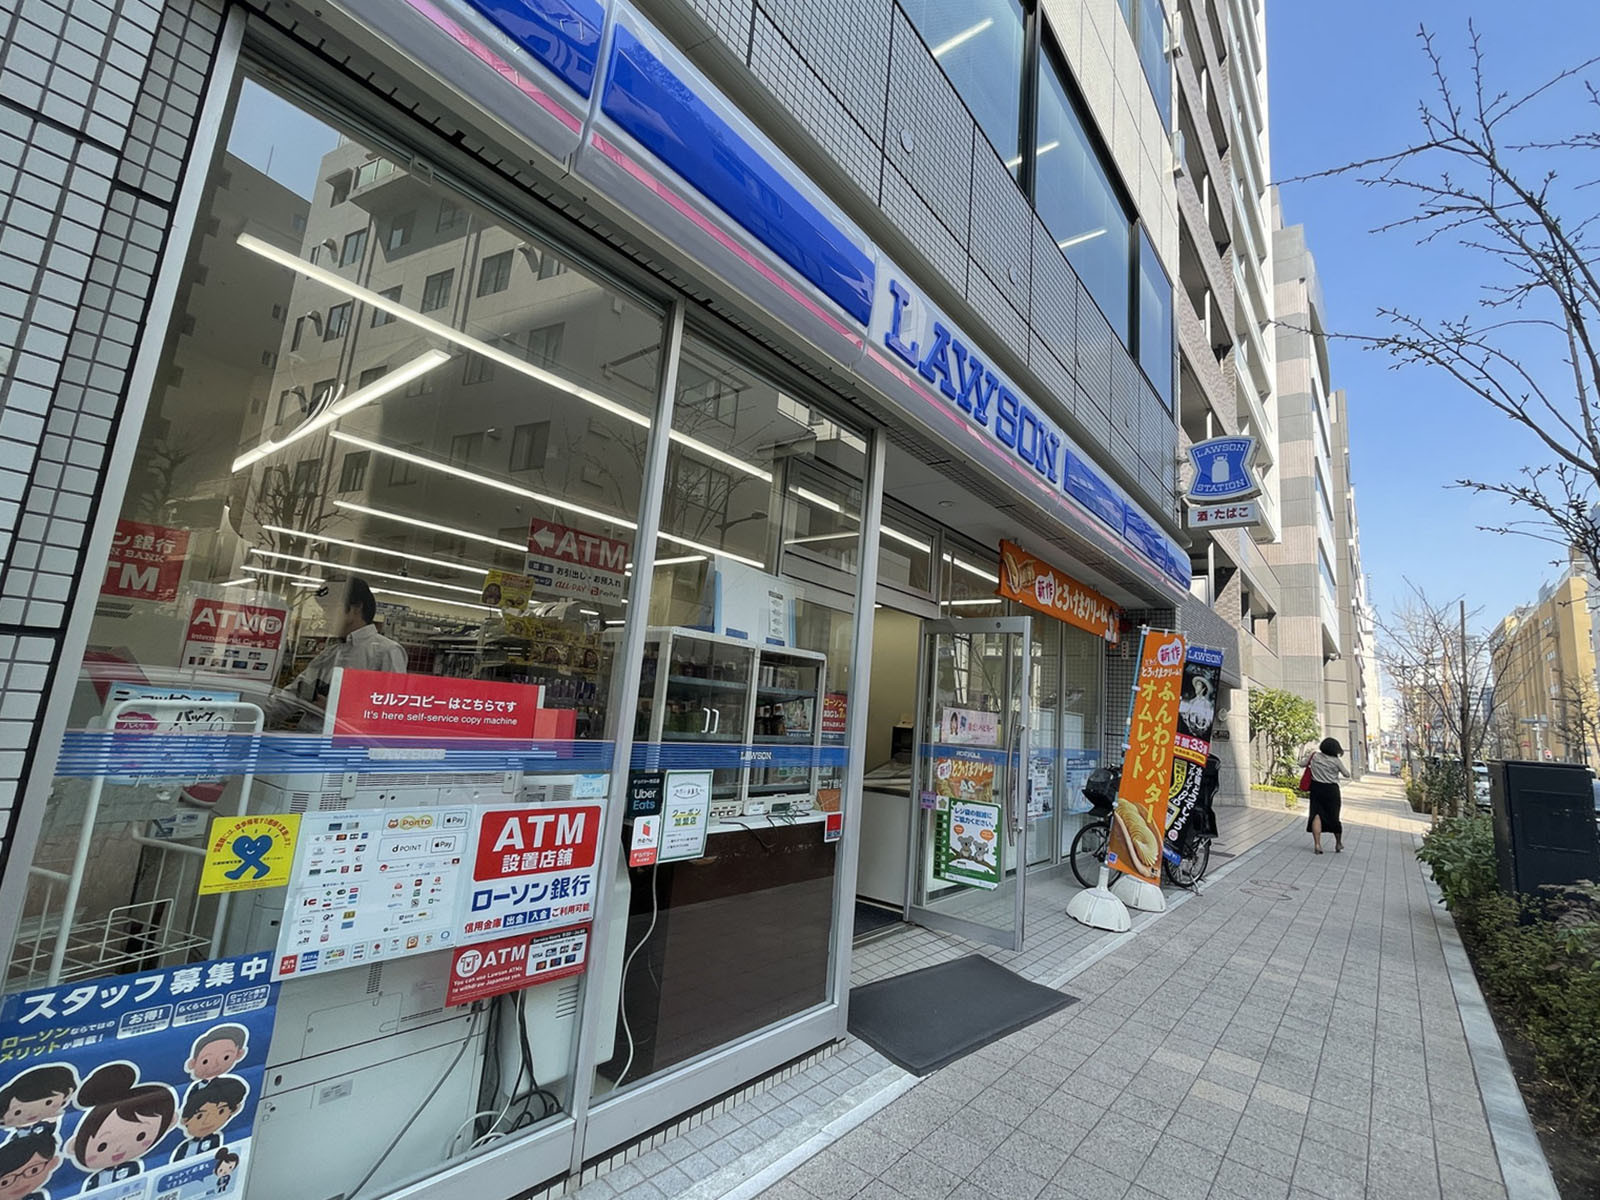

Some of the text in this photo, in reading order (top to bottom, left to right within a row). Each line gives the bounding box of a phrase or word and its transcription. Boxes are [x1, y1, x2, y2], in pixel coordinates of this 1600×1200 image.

[885, 279, 1060, 484] LAWSON
[1196, 443, 1245, 458] LAWSON
[1196, 479, 1245, 492] STATION
[1197, 507, 1248, 522] 酒・たばこ
[125, 550, 165, 563] BANK
[555, 531, 625, 570] ATM
[1160, 646, 1181, 662] 新作
[1187, 650, 1222, 664] LAWSON
[370, 692, 517, 713] セルフコピーはこちらです
[364, 712, 518, 726] It's here self-service copy machine
[1132, 680, 1157, 780] オムレット
[1144, 681, 1176, 824] ふんわりバター
[634, 788, 656, 799] Uber
[632, 800, 655, 810] Eats
[452, 816, 464, 824] Pay
[672, 808, 702, 818] クーポン
[402, 818, 431, 827] Ponta
[492, 813, 586, 852] ATM
[400, 844, 422, 852] POINT
[440, 840, 452, 849] Pay
[501, 848, 574, 874] 設置店舗
[471, 875, 591, 912] ローソン銀行
[464, 902, 590, 933] 信用金庫 出金 入金 ご利用可能
[483, 944, 526, 969] ATM
[454, 978, 464, 986] You
[487, 969, 508, 979] Lawson
[459, 981, 485, 991] withdraw
[486, 976, 511, 986] Japanese
[18, 957, 268, 1024] スタッフ募集中
[179, 998, 220, 1013] らくらくレジ
[1, 1020, 116, 1049] ローソンならではの
